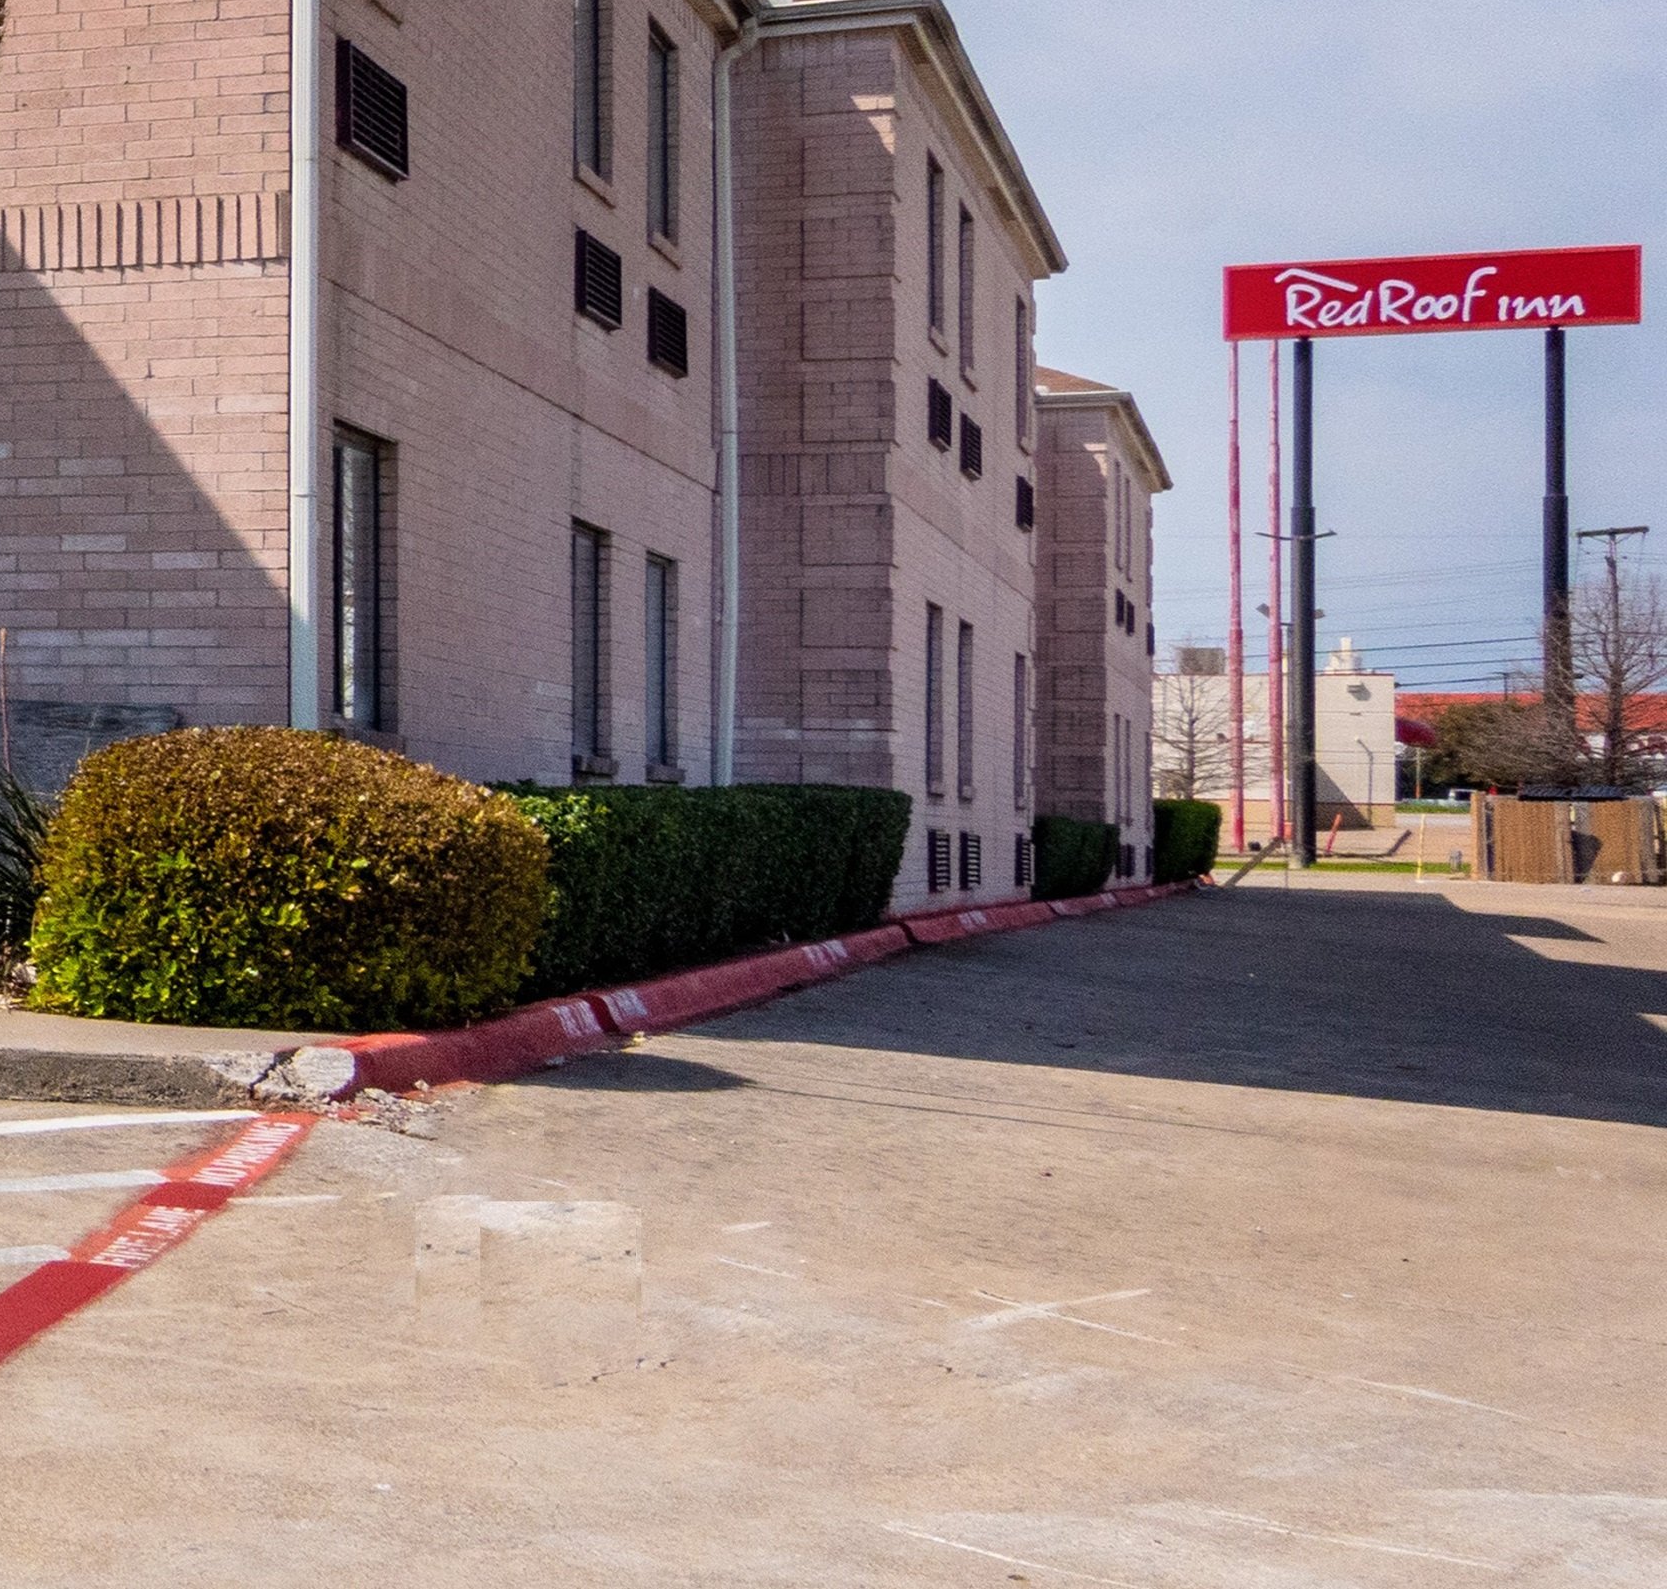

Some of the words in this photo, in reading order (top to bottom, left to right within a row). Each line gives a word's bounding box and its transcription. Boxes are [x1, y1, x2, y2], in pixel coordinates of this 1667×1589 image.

[1285, 284, 1373, 328] Red
[1379, 267, 1497, 324] Roof
[209, 1121, 301, 1169] PARKING
[188, 1167, 248, 1187] NO
[88, 1236, 166, 1269] FIRE
[127, 1206, 206, 1240] LANE
